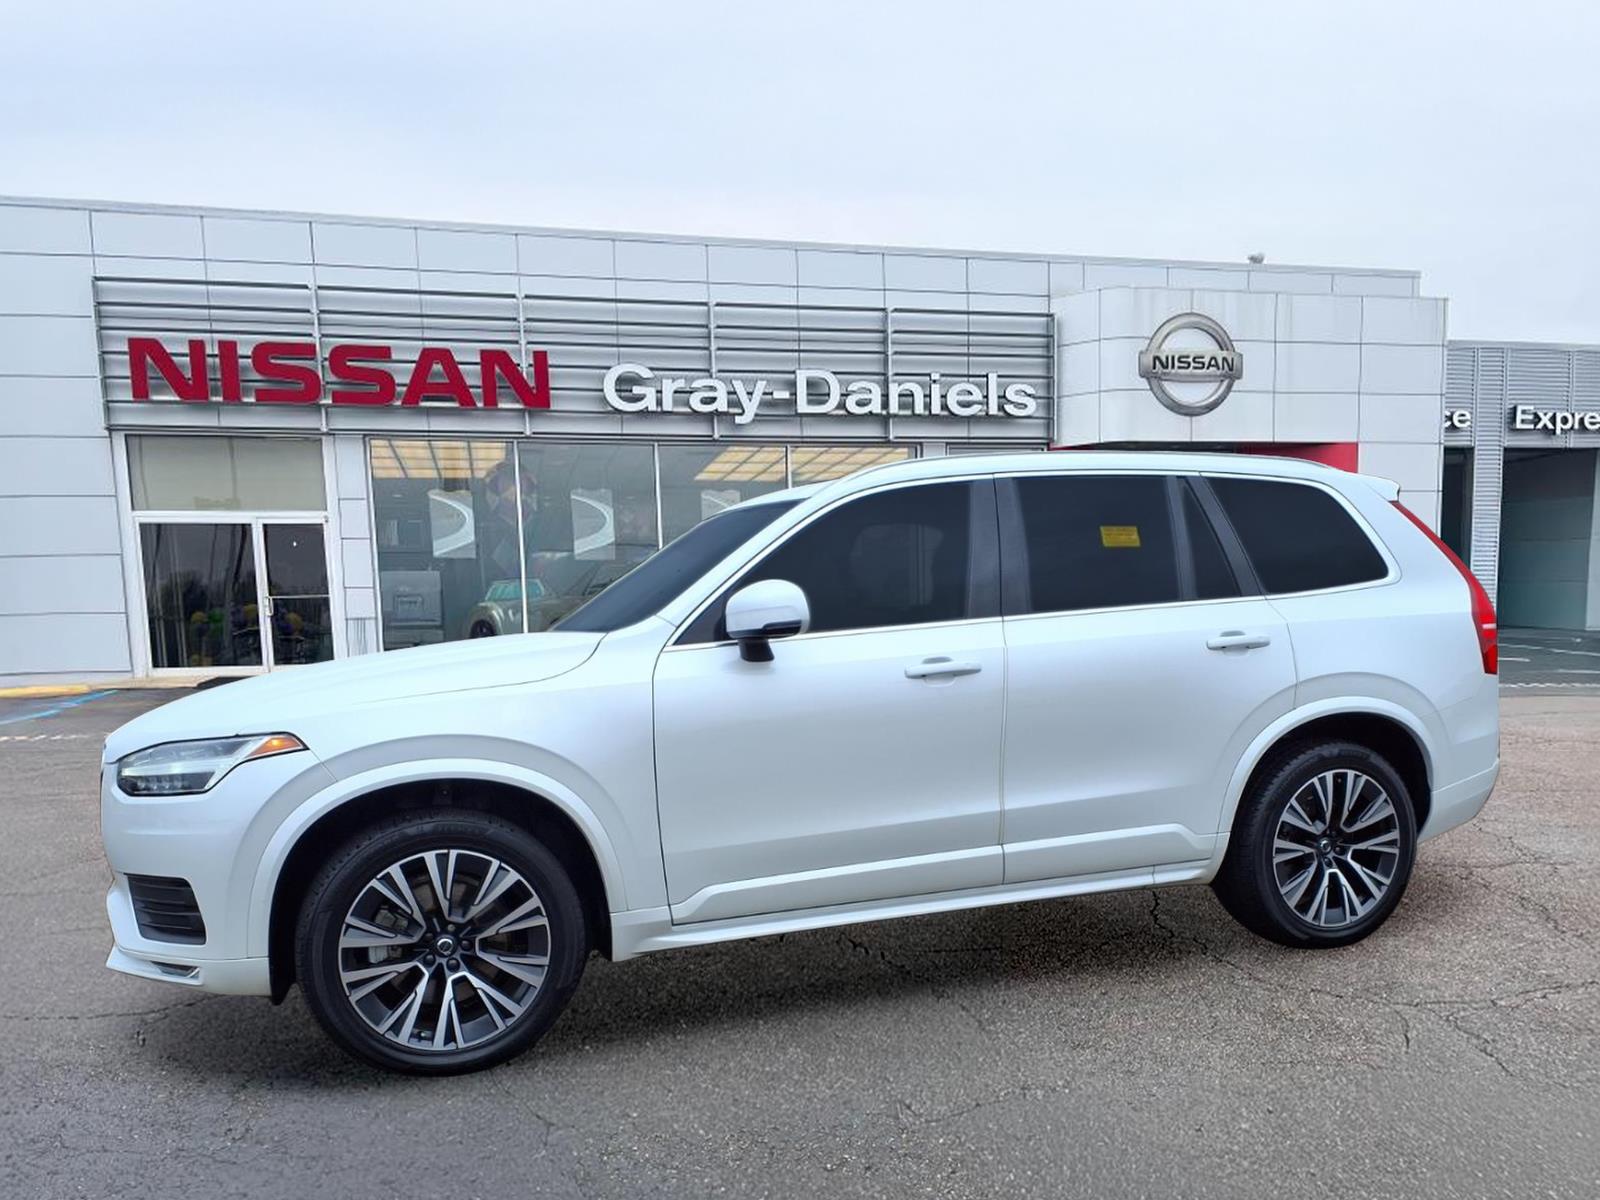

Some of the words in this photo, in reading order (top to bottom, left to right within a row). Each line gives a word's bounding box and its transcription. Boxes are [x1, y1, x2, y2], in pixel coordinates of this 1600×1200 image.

[127, 337, 551, 409] NISSAN
[1152, 354, 1235, 372] NISSAN
[602, 363, 1038, 424] Gray-Daniels
[1514, 405, 1600, 435] Expre
